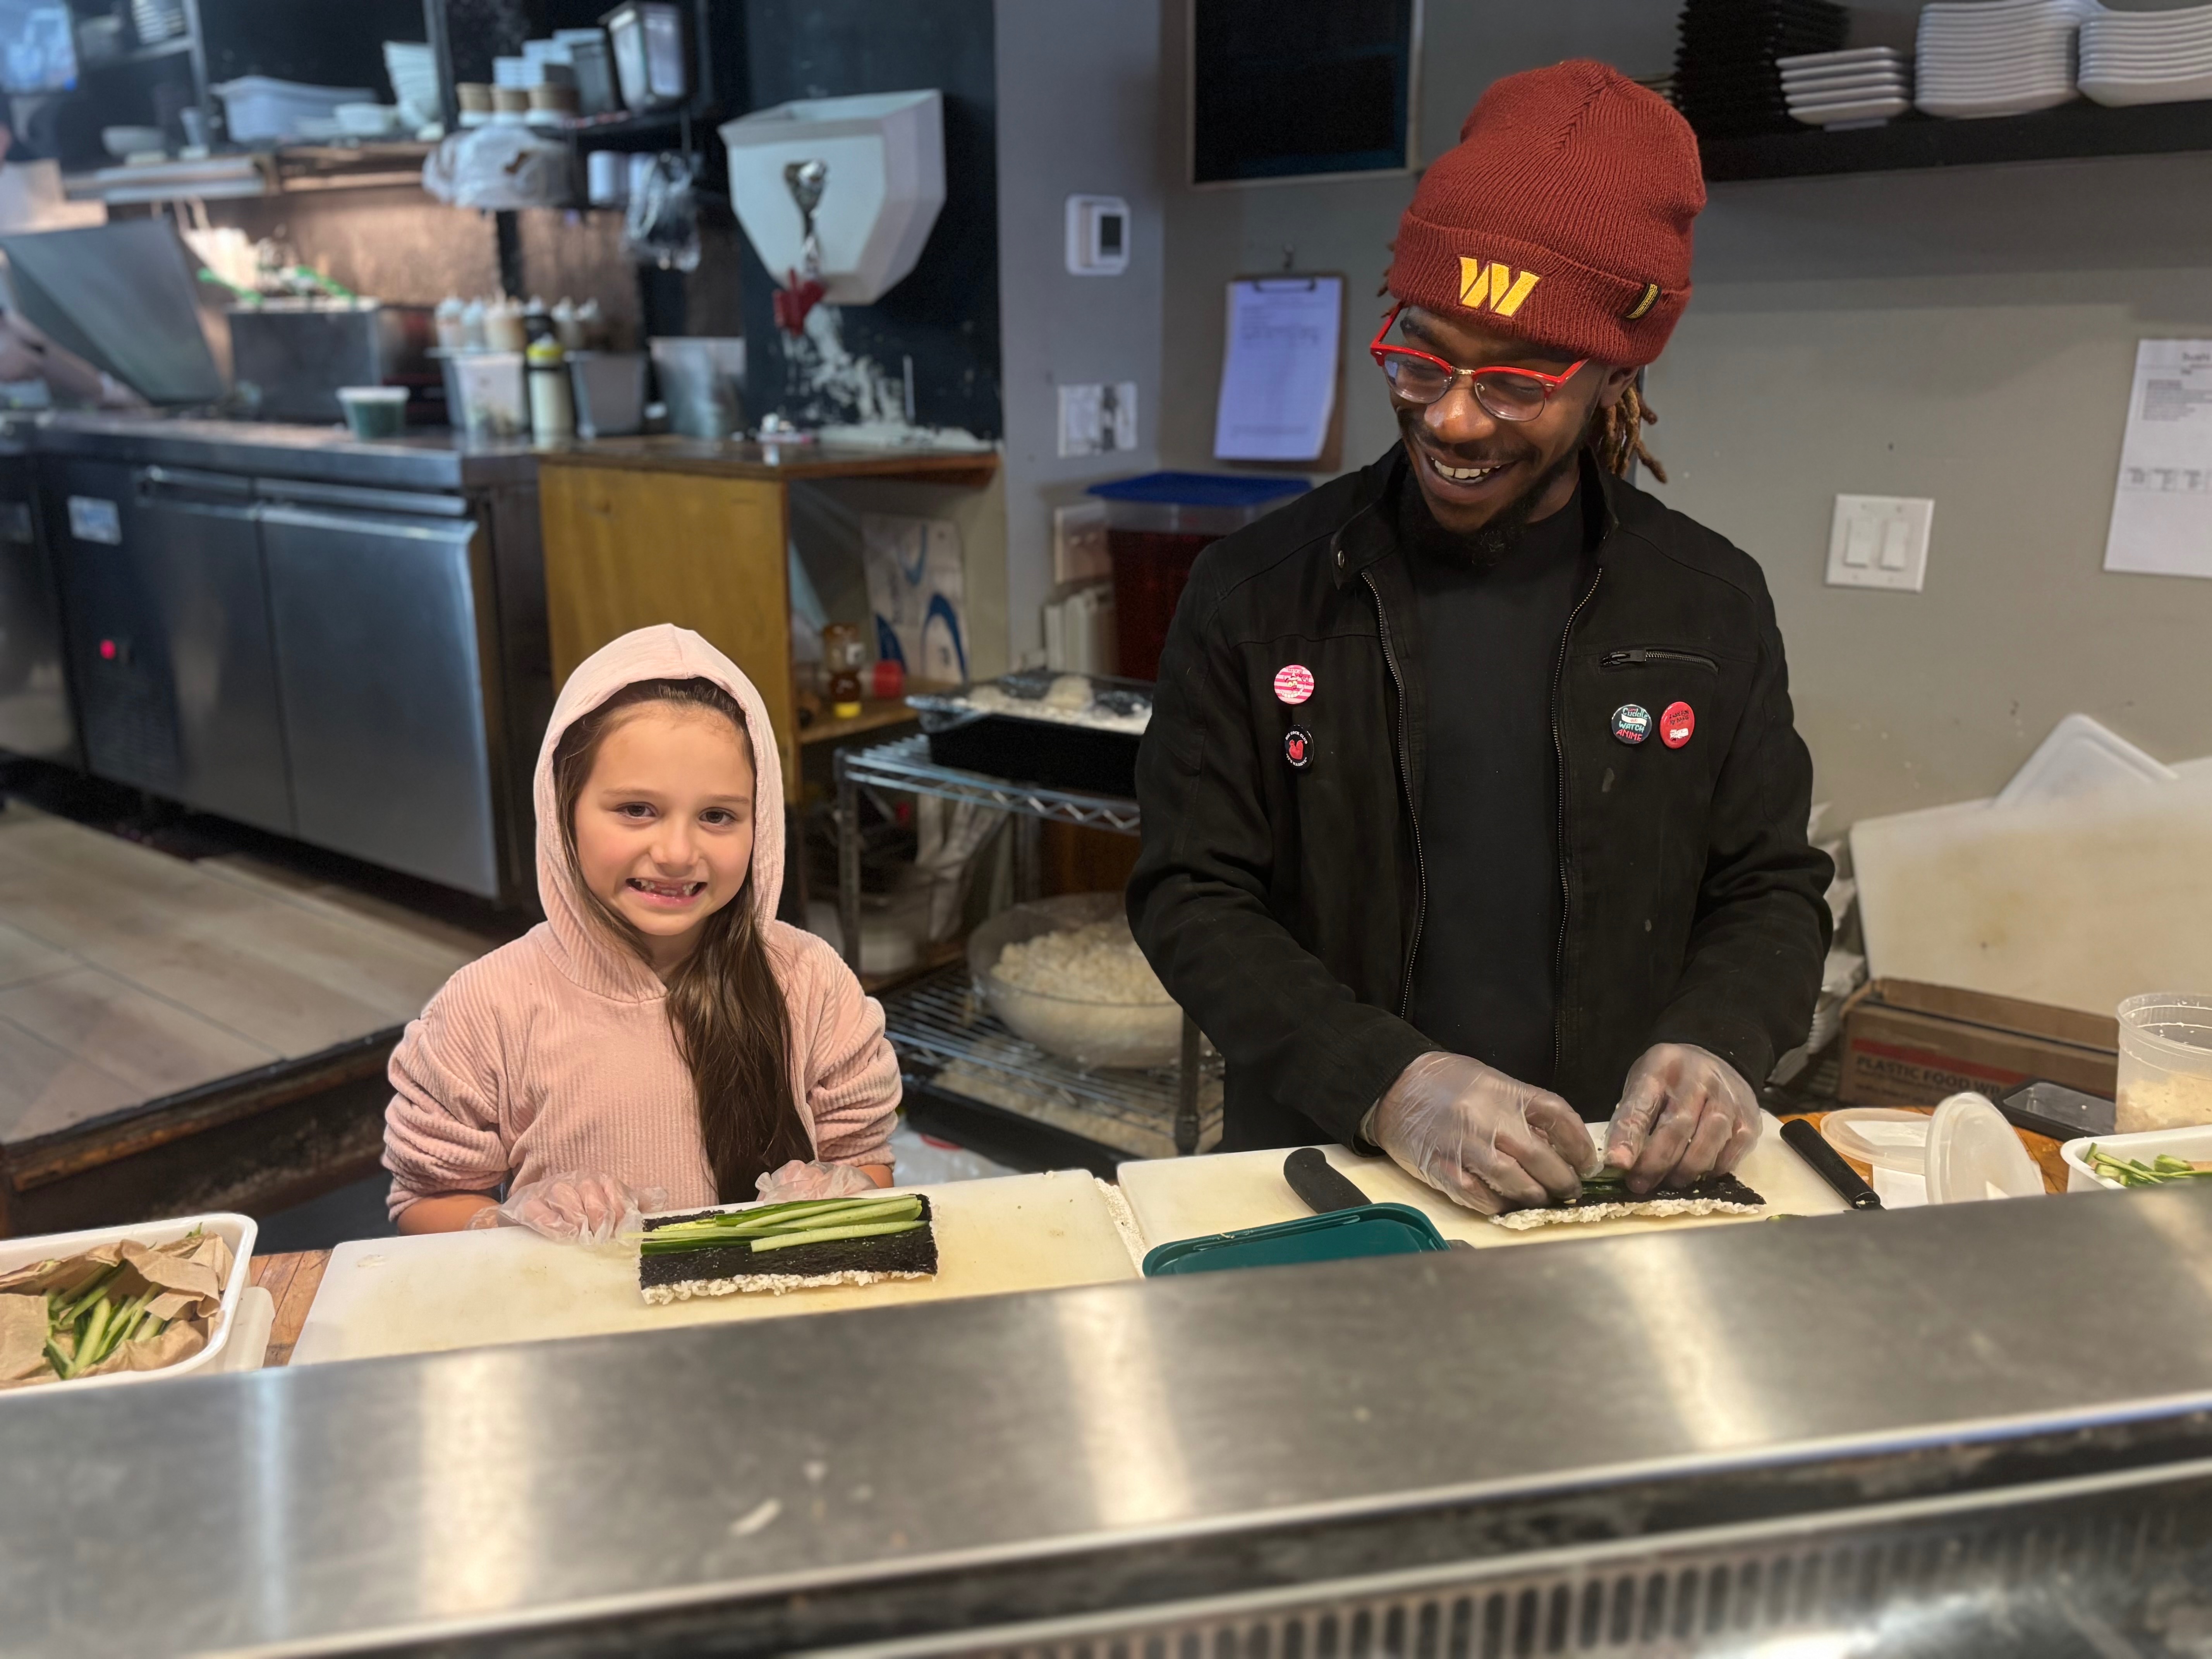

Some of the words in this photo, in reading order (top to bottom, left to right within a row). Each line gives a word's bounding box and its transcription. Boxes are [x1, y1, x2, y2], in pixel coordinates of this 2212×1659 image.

[1619, 720, 1645, 733] WATCH
[1616, 729, 1643, 741] ANIME
[1857, 1054, 1920, 1079] PLASTIC
[1923, 1070, 1970, 1090] FOOD
